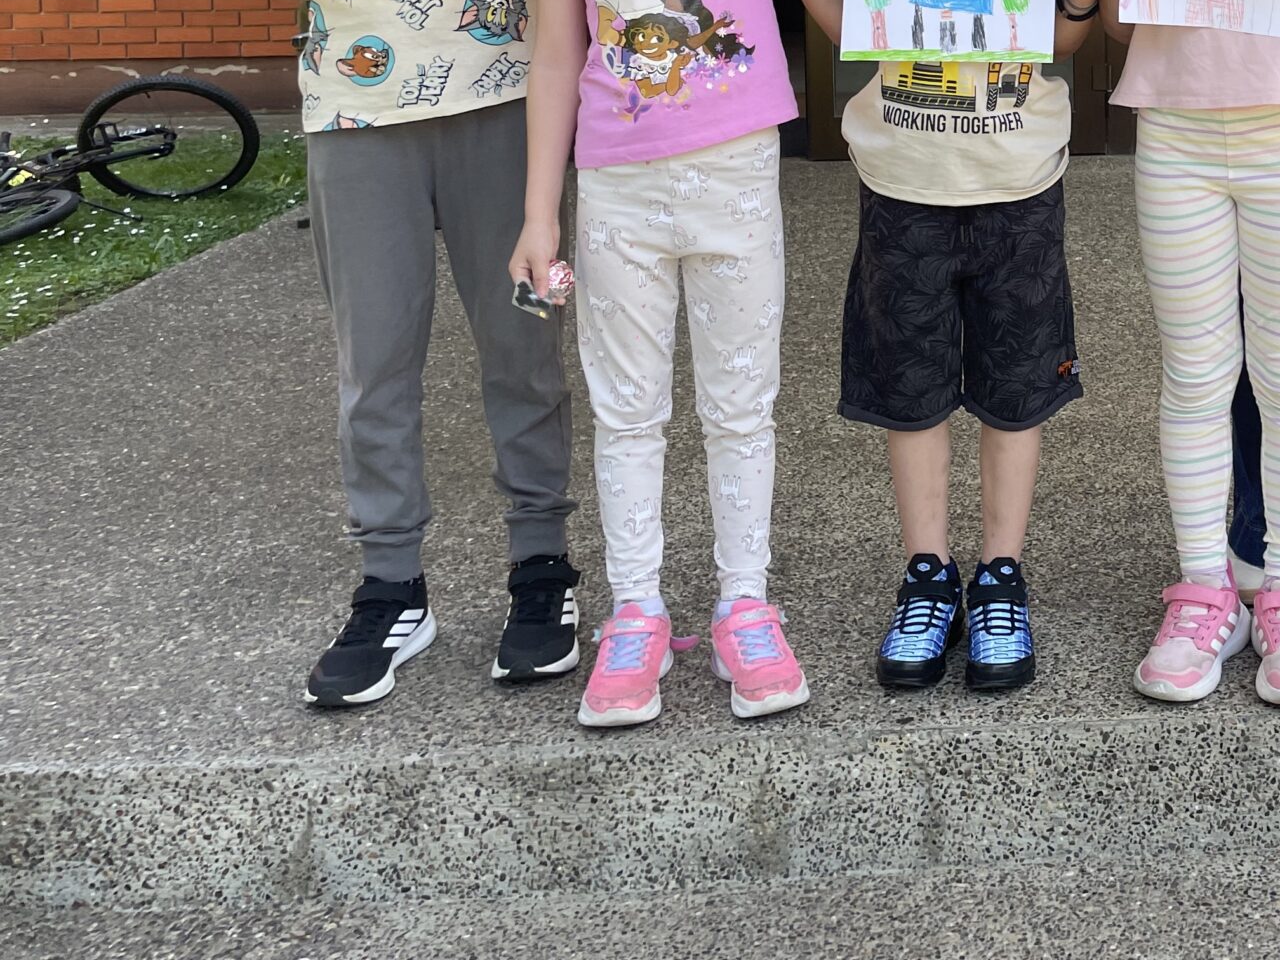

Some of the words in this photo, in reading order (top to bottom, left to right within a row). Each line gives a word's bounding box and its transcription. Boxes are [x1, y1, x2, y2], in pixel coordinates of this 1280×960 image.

[396, 77, 423, 109] TOM
[419, 55, 456, 107] JERRY
[467, 51, 513, 99] JERRY
[883, 104, 947, 133] WORKING
[951, 111, 1024, 134] TOGETHER
